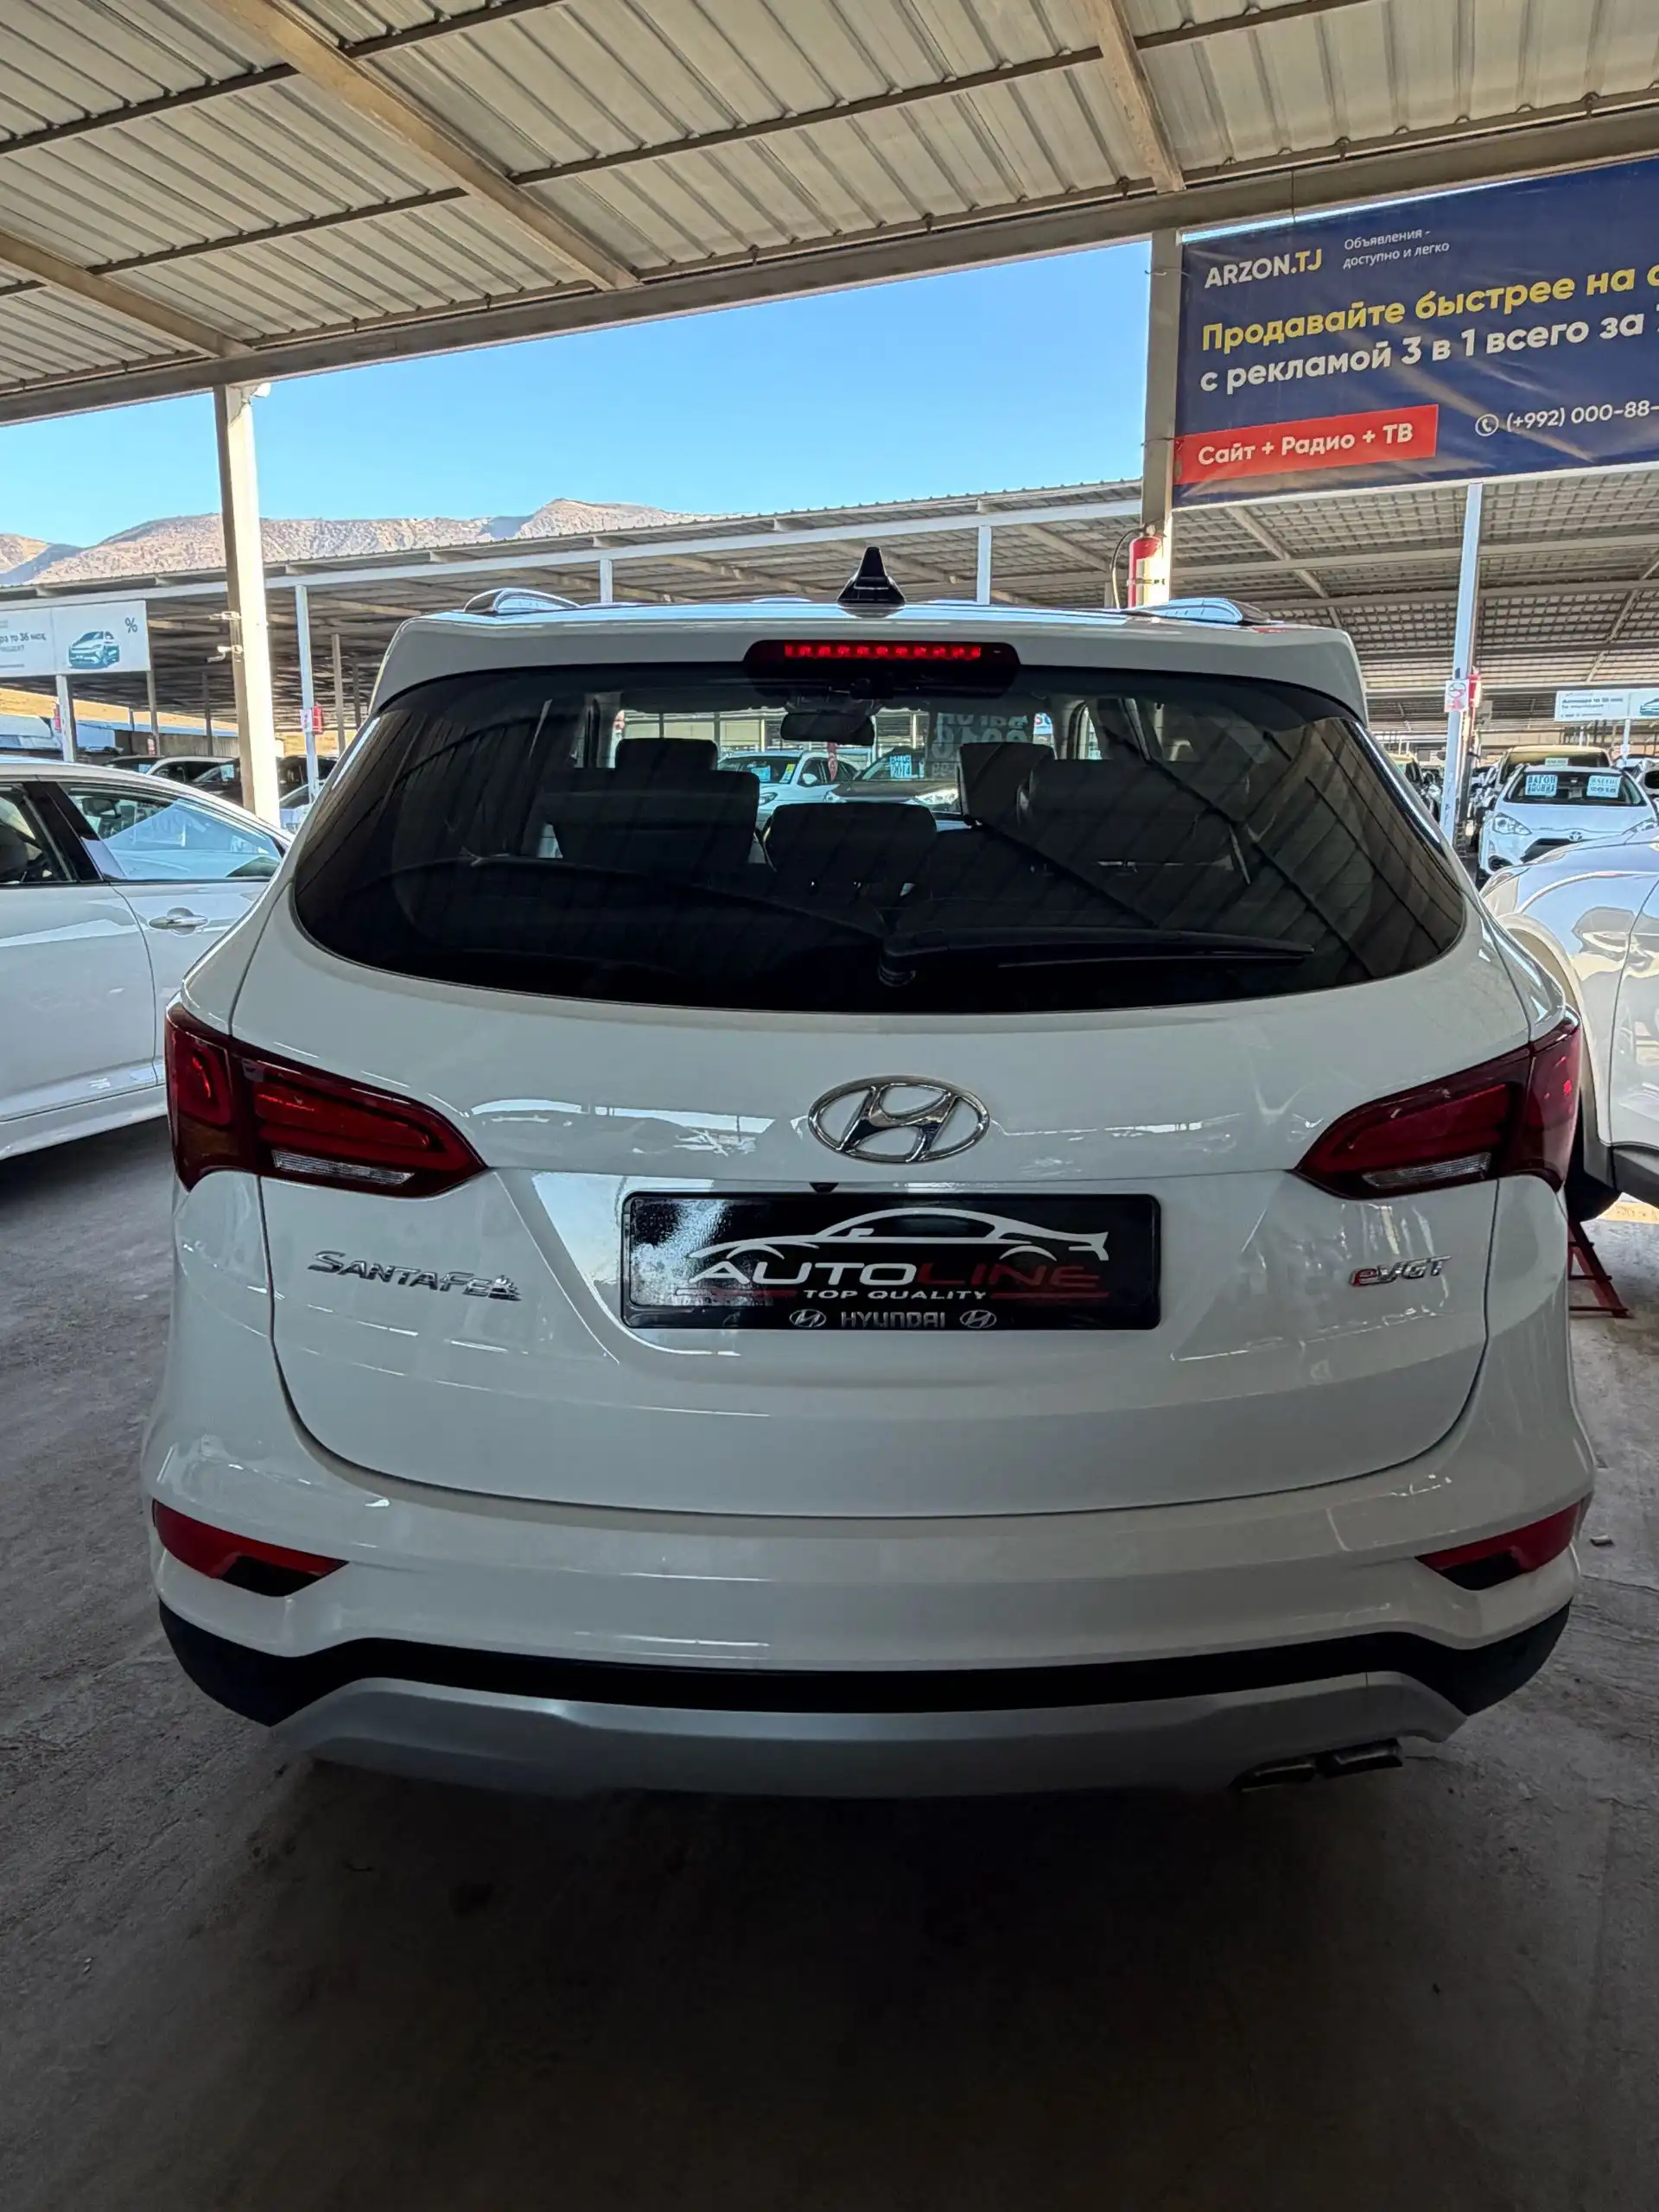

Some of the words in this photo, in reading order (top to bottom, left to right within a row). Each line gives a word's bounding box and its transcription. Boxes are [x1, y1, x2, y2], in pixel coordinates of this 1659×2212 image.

[1344, 228, 1423, 251] Объявления
[1205, 248, 1322, 289] ARZON.TJ
[1343, 249, 1401, 270] доступно
[1402, 247, 1412, 258] и
[1414, 240, 1450, 257] легко
[1202, 301, 1406, 353] Продавайте
[1415, 276, 1575, 320] быстрее
[1586, 268, 1636, 296] на
[1200, 369, 1219, 392] с
[1226, 340, 1392, 395] рекламой
[1401, 335, 1422, 365] 3
[1432, 339, 1452, 361] в
[1460, 328, 1477, 356] 1
[1485, 321, 1590, 354] всего
[1599, 313, 1645, 340] за
[1506, 407, 1566, 432] (+992)
[1198, 442, 1256, 466] Сайт
[1281, 431, 1356, 457] Радио
[1382, 422, 1414, 444] ТВ
[689, 1262, 1103, 1287] AUTOLINE
[802, 1288, 859, 1300] TOP
[867, 1288, 988, 1302] QUALITY
[839, 1311, 947, 1330] HYUNDAI
